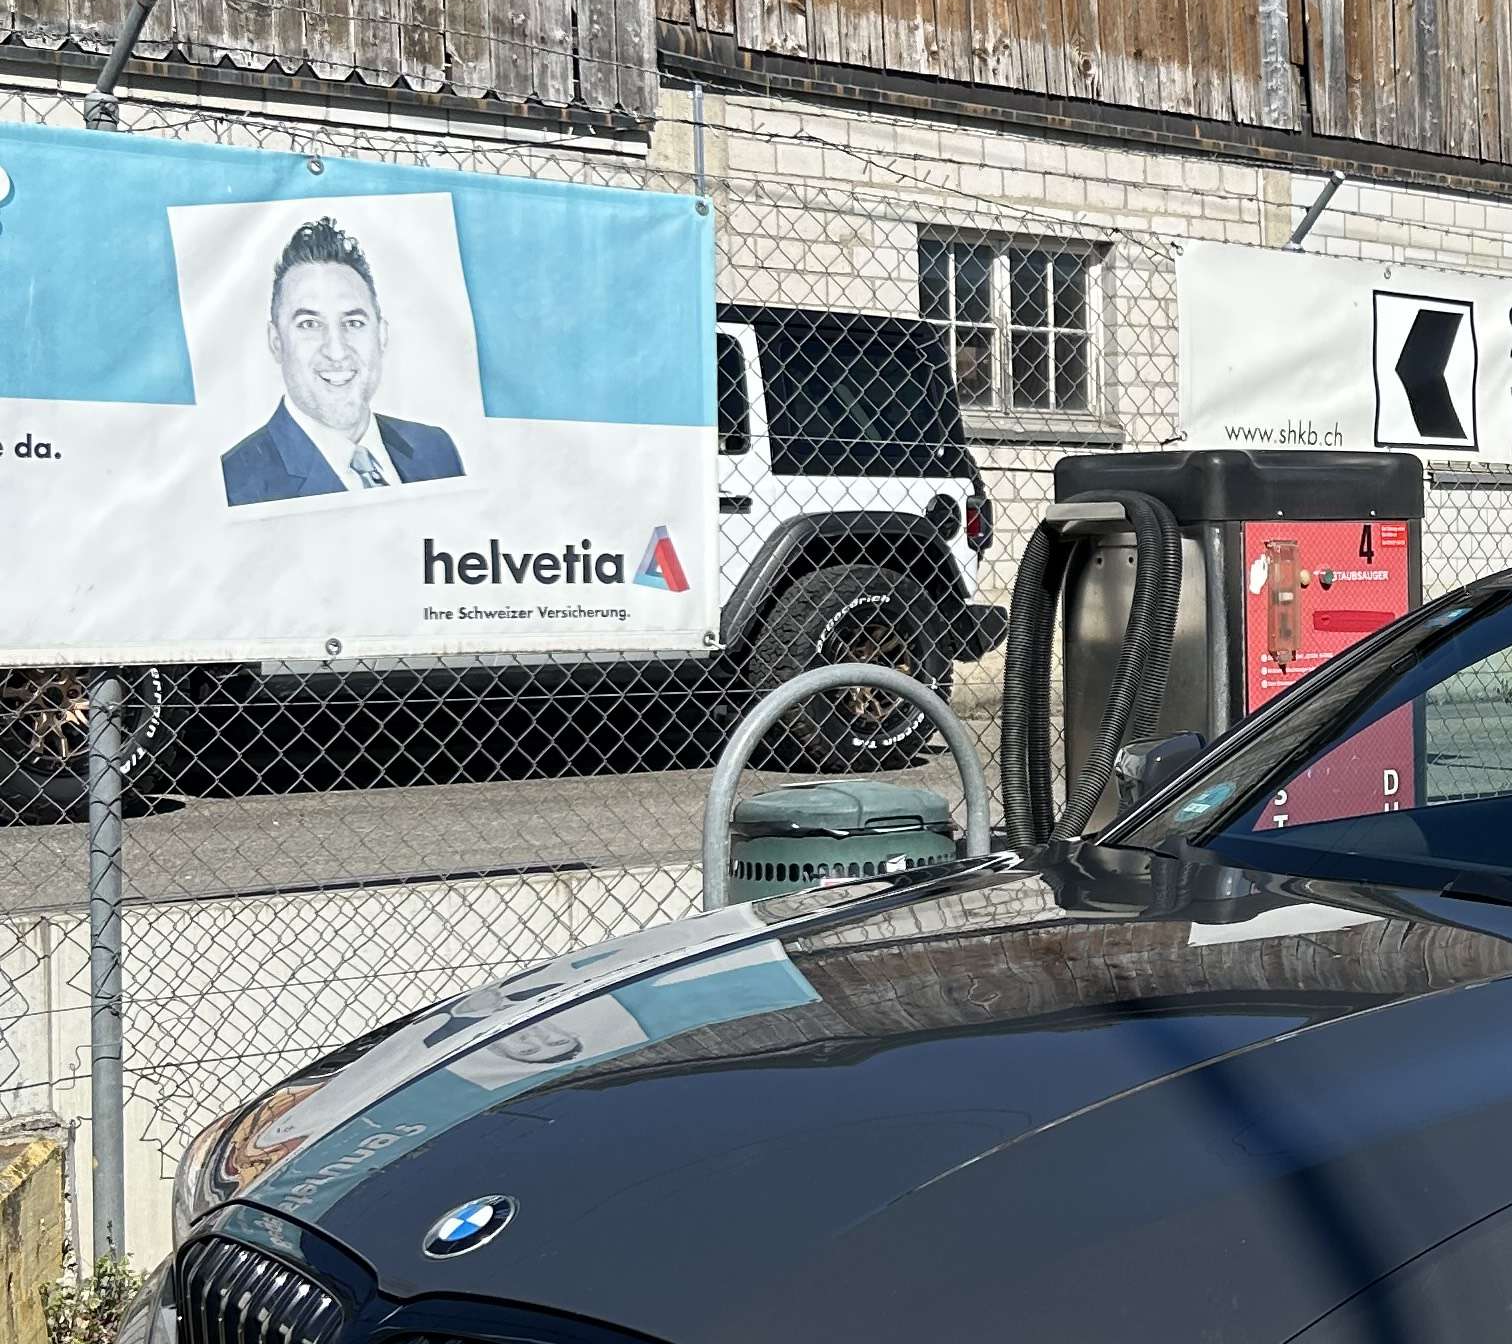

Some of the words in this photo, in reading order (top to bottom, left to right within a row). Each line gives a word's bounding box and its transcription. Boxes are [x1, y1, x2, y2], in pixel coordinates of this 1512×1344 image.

[15, 433, 62, 459] da.
[1224, 419, 1343, 447] www.shkb.ch
[1359, 524, 1375, 564] 4
[423, 538, 625, 585] helvetia
[423, 607, 453, 620] Ihre
[458, 606, 533, 619] Schweizer
[537, 605, 631, 621] Versicherung.
